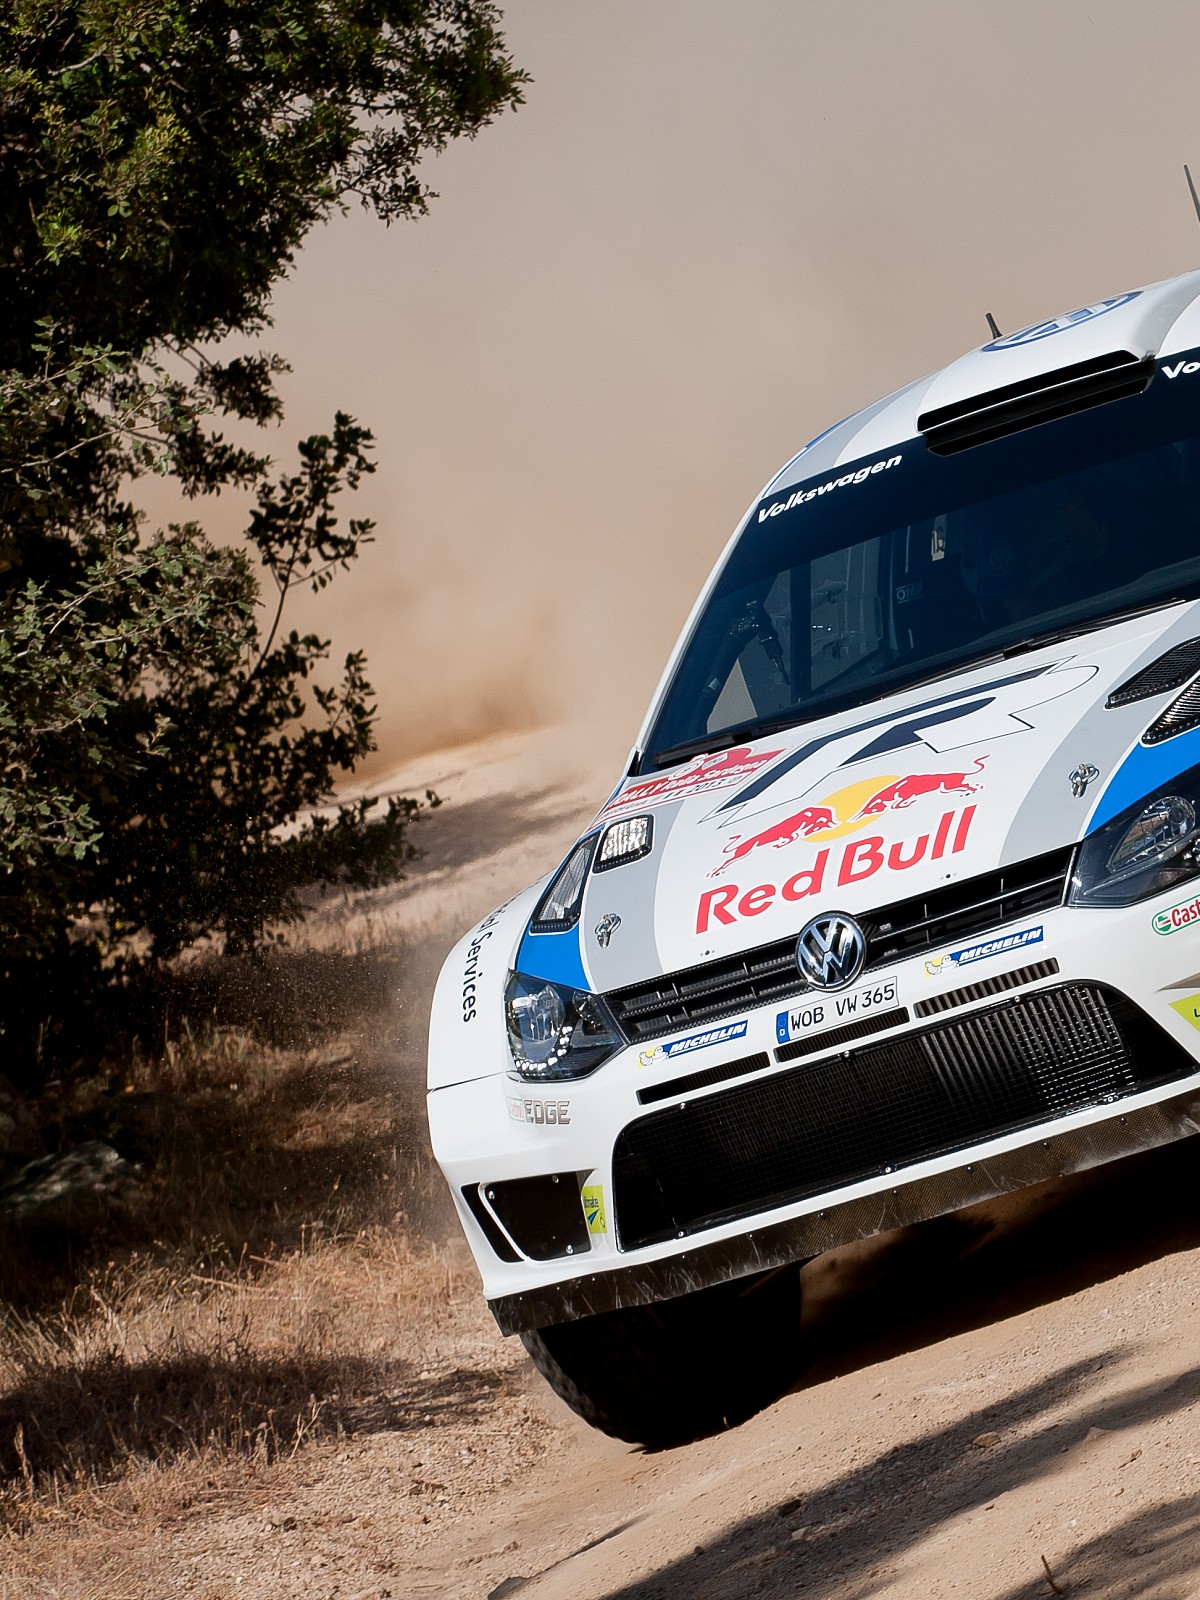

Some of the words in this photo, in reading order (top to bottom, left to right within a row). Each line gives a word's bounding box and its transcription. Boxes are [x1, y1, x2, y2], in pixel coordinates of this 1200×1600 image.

[758, 455, 903, 523] Volkswagen
[695, 848, 830, 934] Red
[837, 804, 978, 887] Bull
[958, 928, 1042, 961] MICHELIN
[463, 931, 493, 1023] Services
[790, 1006, 825, 1031] WOB
[835, 995, 858, 1017] VW
[861, 983, 895, 1008] 365
[669, 1023, 747, 1054] MICHELIN
[523, 1099, 571, 1125] EDGE
